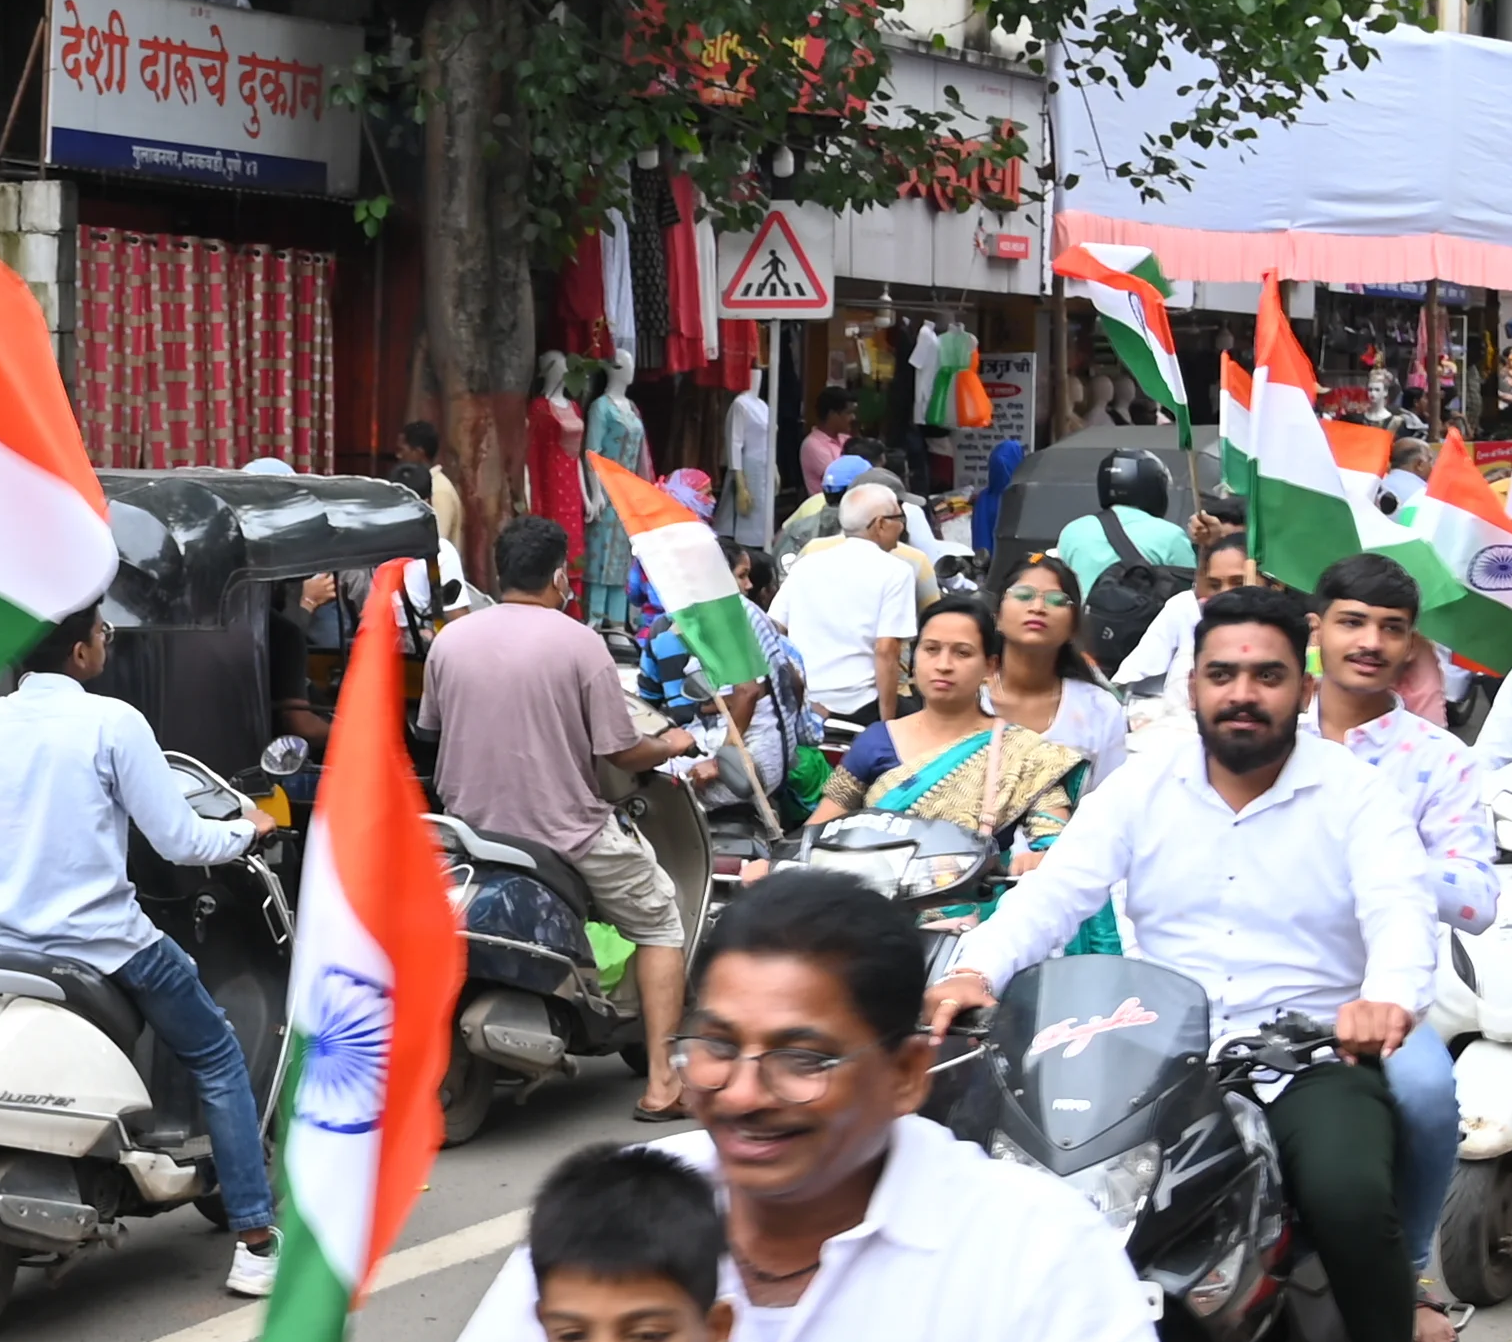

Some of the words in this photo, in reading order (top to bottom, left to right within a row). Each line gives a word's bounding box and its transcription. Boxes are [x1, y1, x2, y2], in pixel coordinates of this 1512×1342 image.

[61, 0, 129, 94] देशी
[139, 25, 228, 106] दारूचे
[238, 52, 323, 138] दुकान
